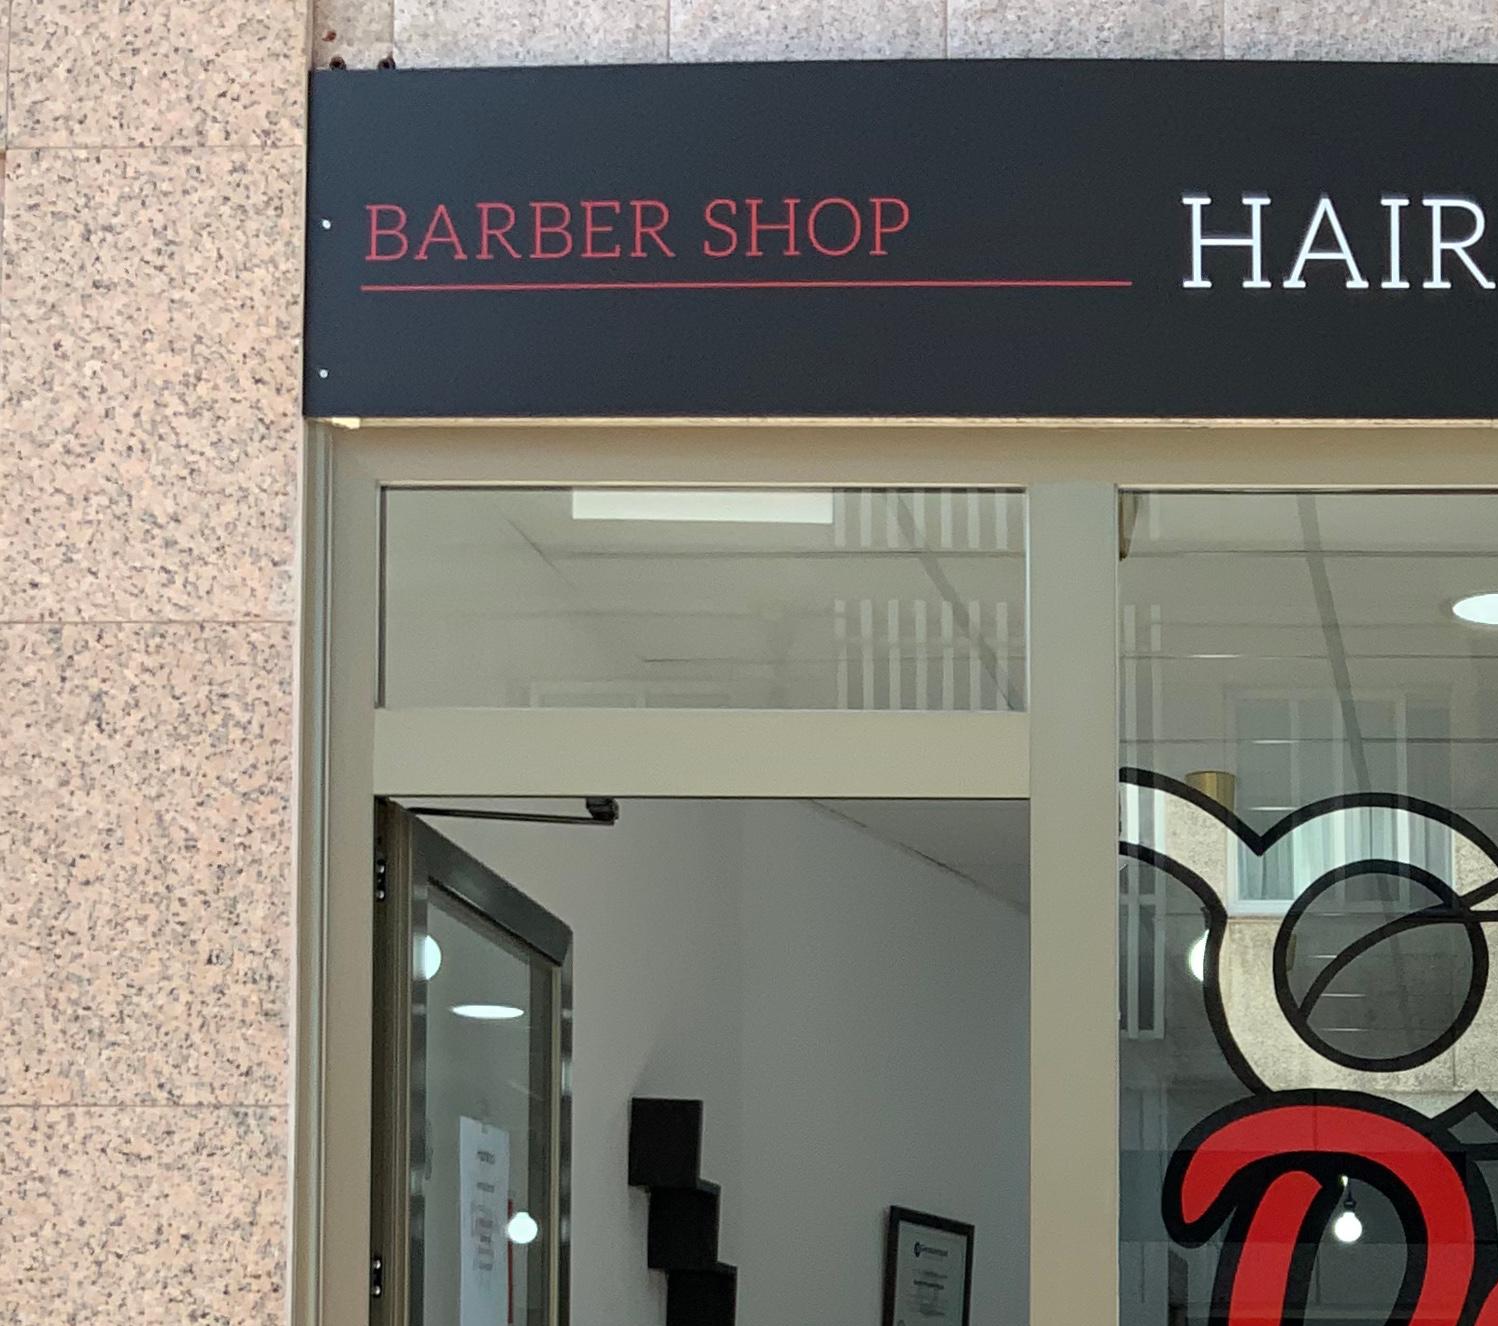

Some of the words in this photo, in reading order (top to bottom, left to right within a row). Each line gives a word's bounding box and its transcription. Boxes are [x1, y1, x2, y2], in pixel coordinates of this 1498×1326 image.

[364, 201, 677, 261] BARBER
[703, 198, 910, 257] SHOP
[1182, 197, 1496, 289] HAIR
